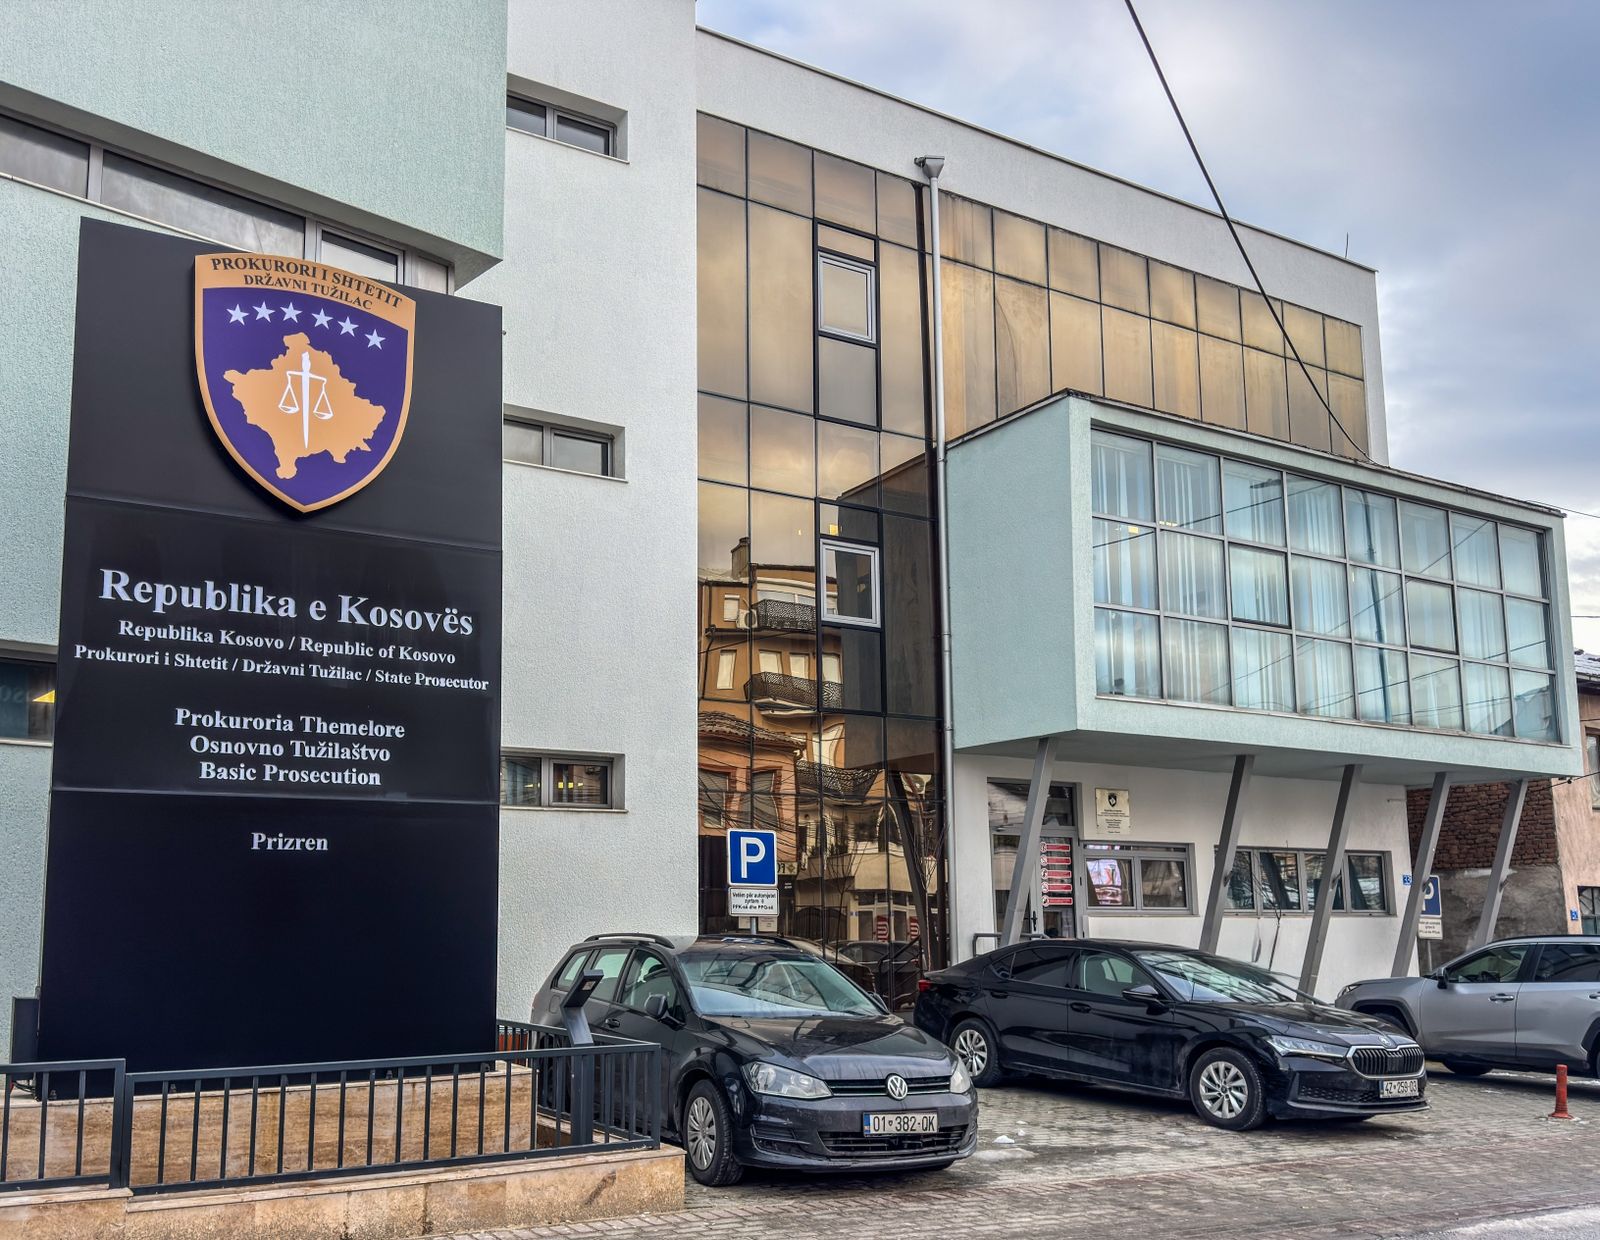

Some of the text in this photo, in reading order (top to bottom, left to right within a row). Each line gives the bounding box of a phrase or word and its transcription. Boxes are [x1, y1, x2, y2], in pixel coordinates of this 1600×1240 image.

[211, 257, 402, 308] PROKURORI I SHTETIT
[244, 271, 373, 310] DRŽAVNI TUŽILAC
[99, 569, 297, 617] Republika
[338, 595, 472, 635] Kosovës
[119, 620, 213, 643] Republika
[220, 630, 284, 649] Kosovo
[300, 637, 373, 656] Republic
[379, 645, 395, 658] of
[399, 646, 455, 664] Kosovo
[74, 645, 159, 664] Prokurori
[175, 653, 228, 670] Shtetit
[242, 659, 304, 676] Državni
[309, 665, 362, 680] Tužilac
[376, 670, 411, 684] State
[415, 672, 489, 690] Prosecutor
[175, 708, 404, 738] Prokuroria Themelore
[190, 735, 390, 761] Osnovno Tužilaštvo
[199, 762, 381, 785] Basic Prosecution
[251, 833, 328, 850] Prizren
[740, 837, 766, 878] P
